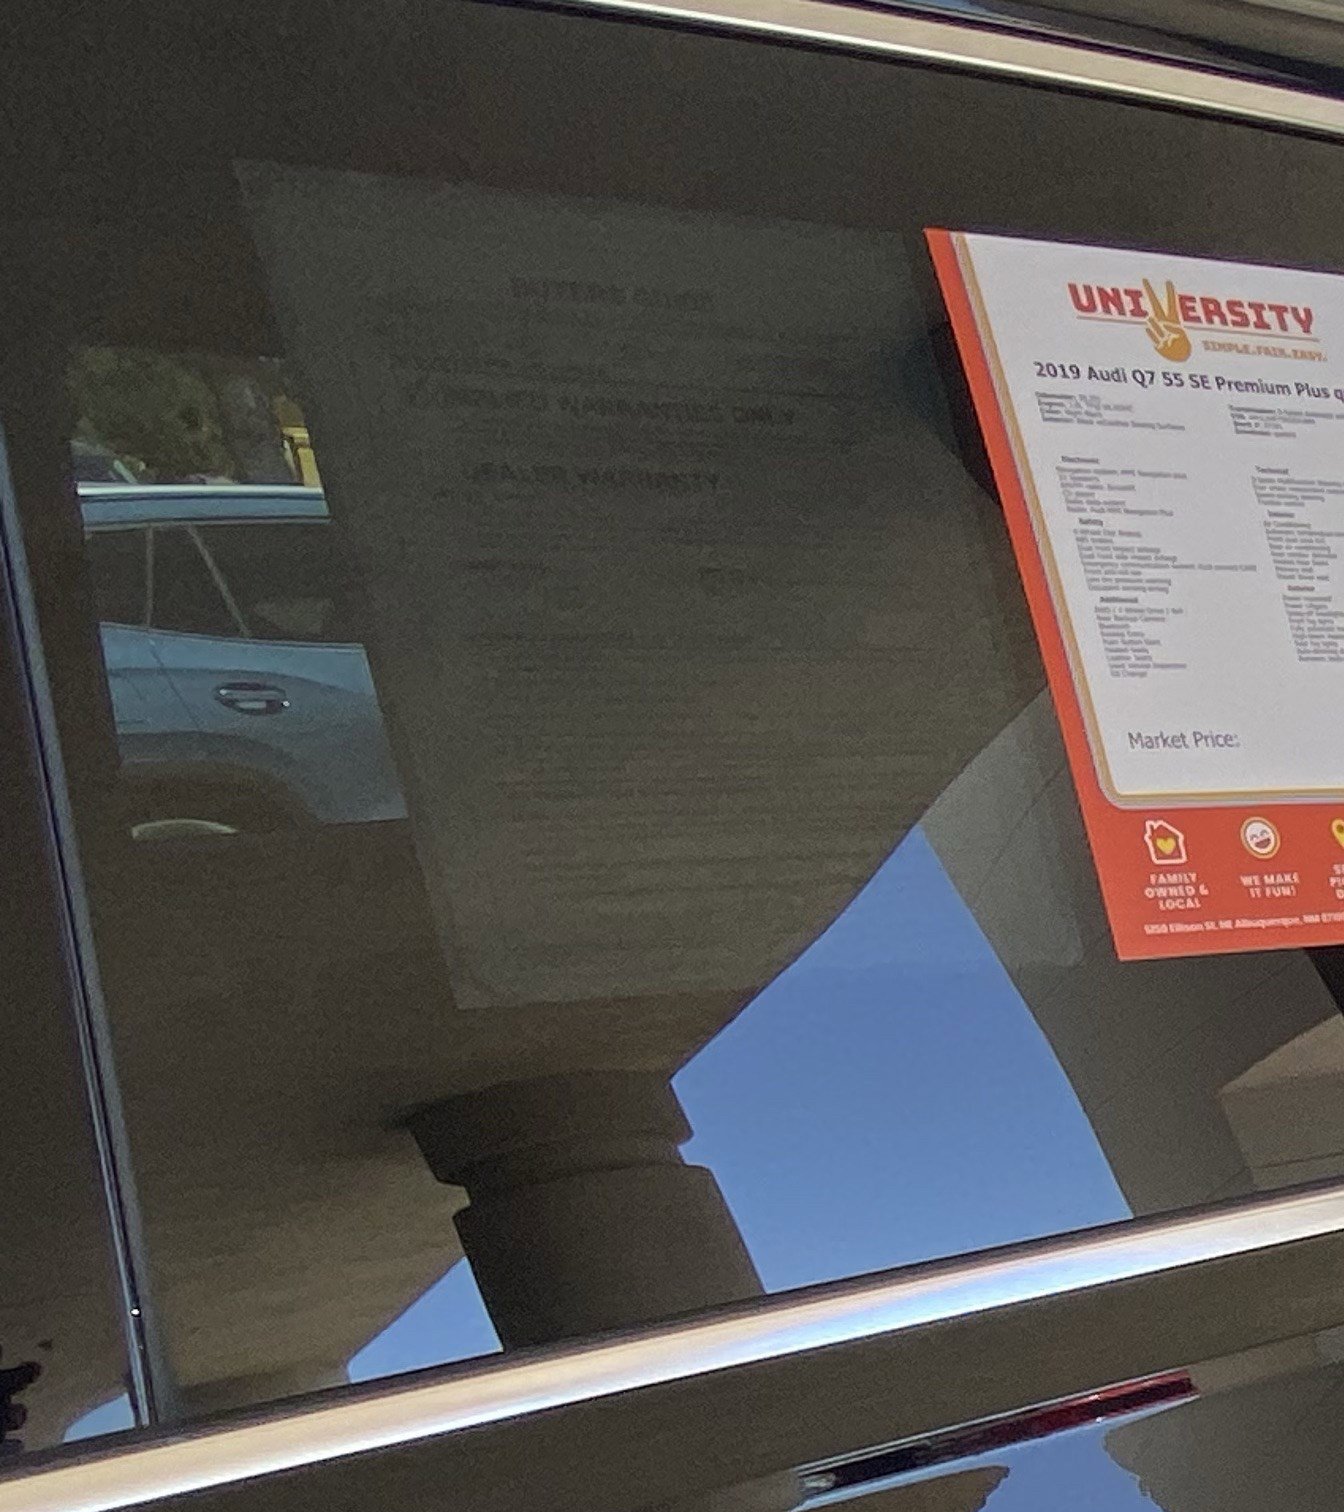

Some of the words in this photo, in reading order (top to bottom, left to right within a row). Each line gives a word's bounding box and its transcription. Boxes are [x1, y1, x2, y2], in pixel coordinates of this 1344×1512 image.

[1067, 280, 1315, 335] UNIVERSITY
[1033, 361, 1081, 380] 2019
[1088, 366, 1128, 384] Audi
[1132, 370, 1155, 388] Q7
[1190, 374, 1211, 390] SE
[1215, 377, 1291, 396] Premium
[1294, 381, 1331, 399] Plus
[1127, 731, 1189, 750] Market
[1193, 730, 1241, 749] Price:
[1150, 872, 1198, 885] FAMILY
[1263, 872, 1300, 886] MAKE
[1144, 884, 1196, 899] OWNED
[1158, 897, 1202, 911] LOCAL
